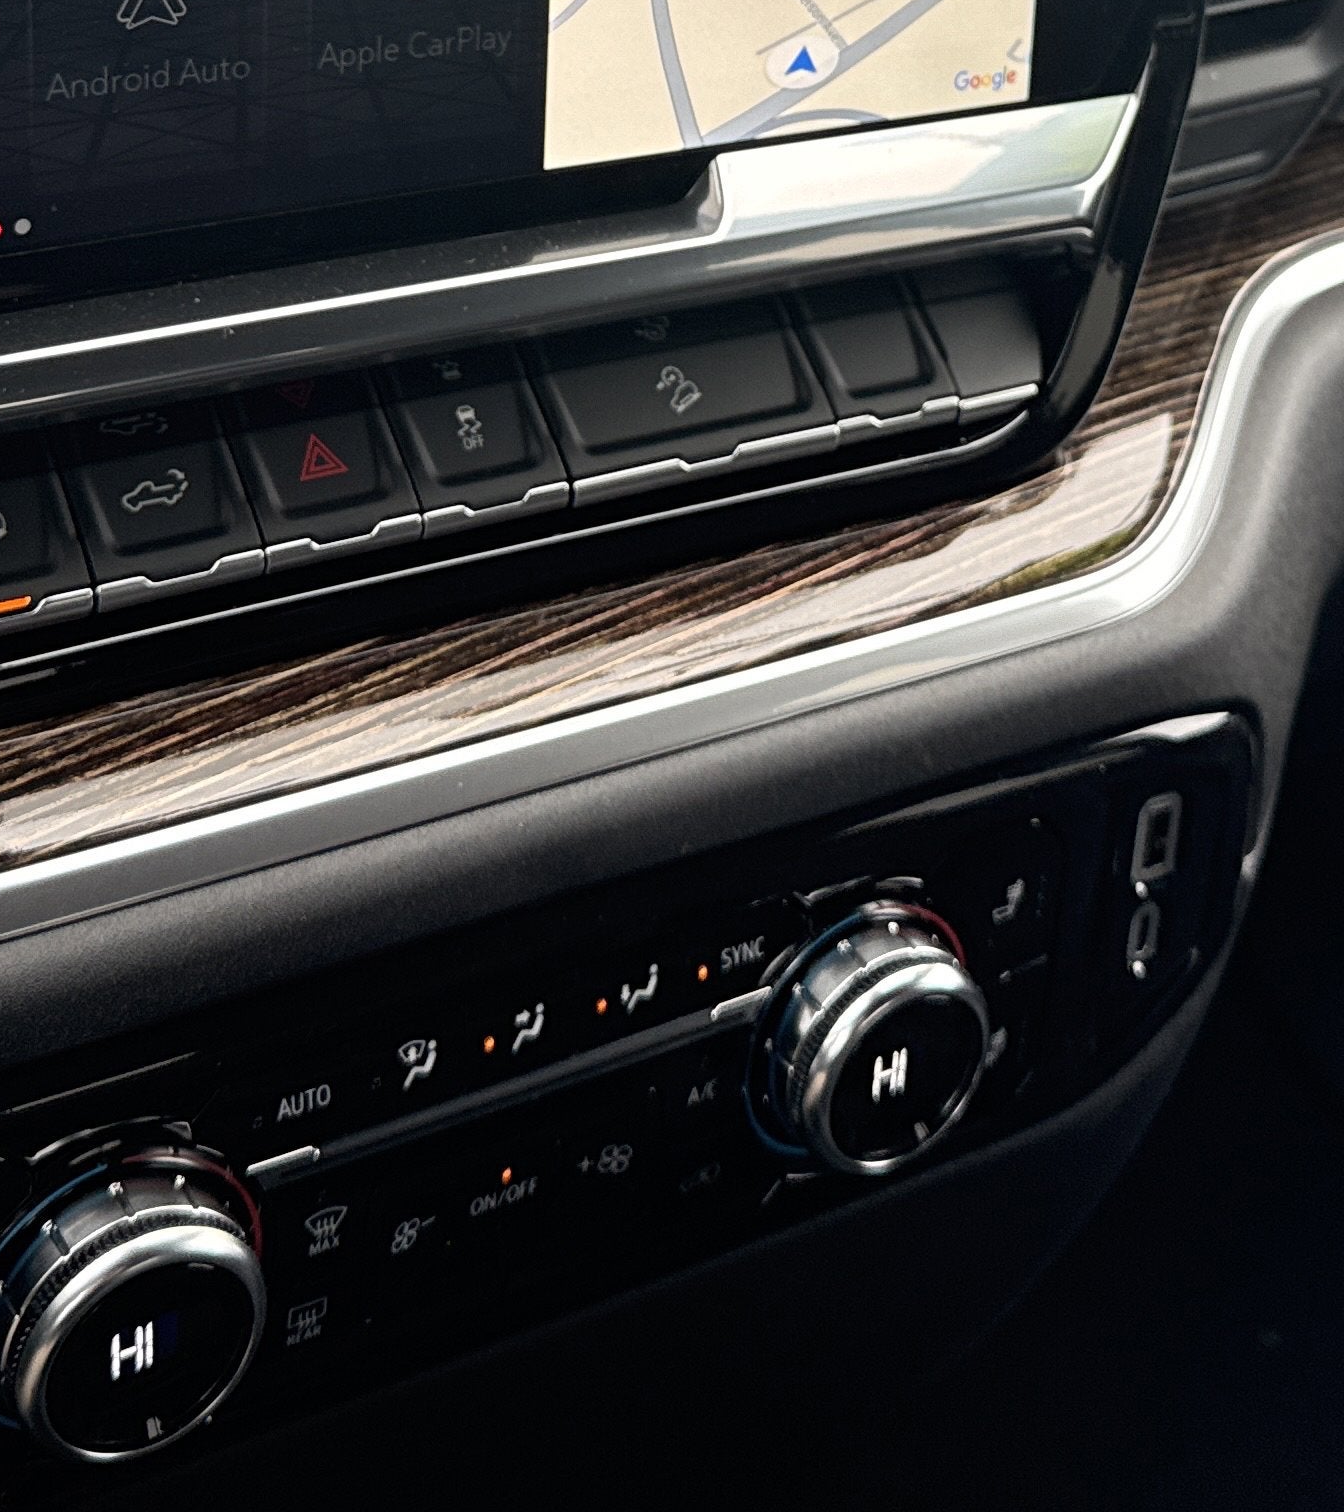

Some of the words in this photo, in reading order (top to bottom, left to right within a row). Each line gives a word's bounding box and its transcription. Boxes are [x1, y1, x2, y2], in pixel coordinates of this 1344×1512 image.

[316, 36, 400, 76] Apple
[407, 24, 513, 60] CarPlay
[45, 61, 171, 102] Android
[178, 57, 251, 85] Auto
[953, 65, 1017, 91] Google
[719, 935, 766, 971] SYNC
[871, 1046, 908, 1103] HI
[276, 1083, 332, 1122] AUTO
[308, 1234, 341, 1258] MAX
[110, 1320, 155, 1381] HI
